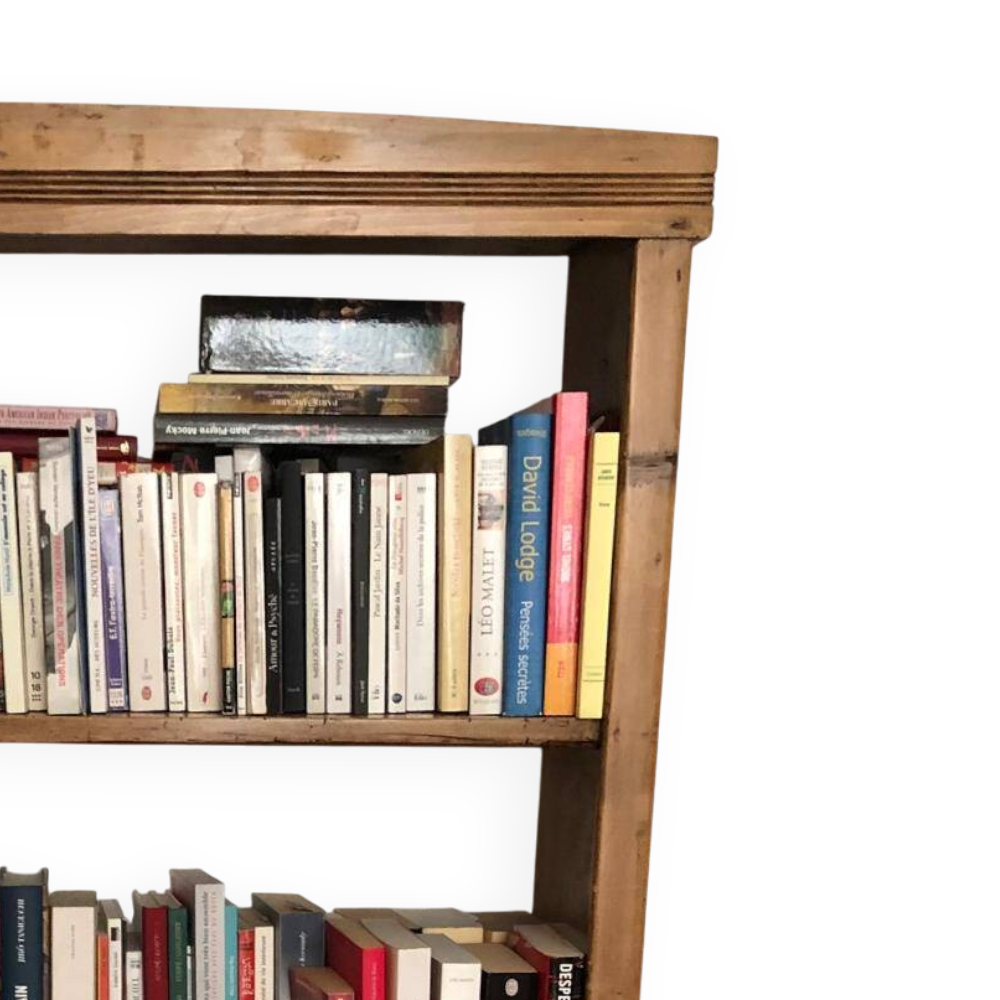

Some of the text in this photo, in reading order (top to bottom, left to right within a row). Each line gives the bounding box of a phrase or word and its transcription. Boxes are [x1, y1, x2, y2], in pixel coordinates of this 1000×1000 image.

[87, 466, 96, 495] D'YEU
[88, 525, 97, 540] DE
[89, 542, 99, 597] NOUVELLES
[374, 552, 381, 562] Le
[478, 548, 495, 635] LÉO MALET
[516, 456, 542, 704] David Lodge Pensées secrètes
[268, 594, 280, 628] Psyché
[168, 655, 176, 693] Jean-Paul
[269, 639, 279, 674] Amour
[202, 892, 210, 927] ensemble
[204, 981, 212, 991] qui
